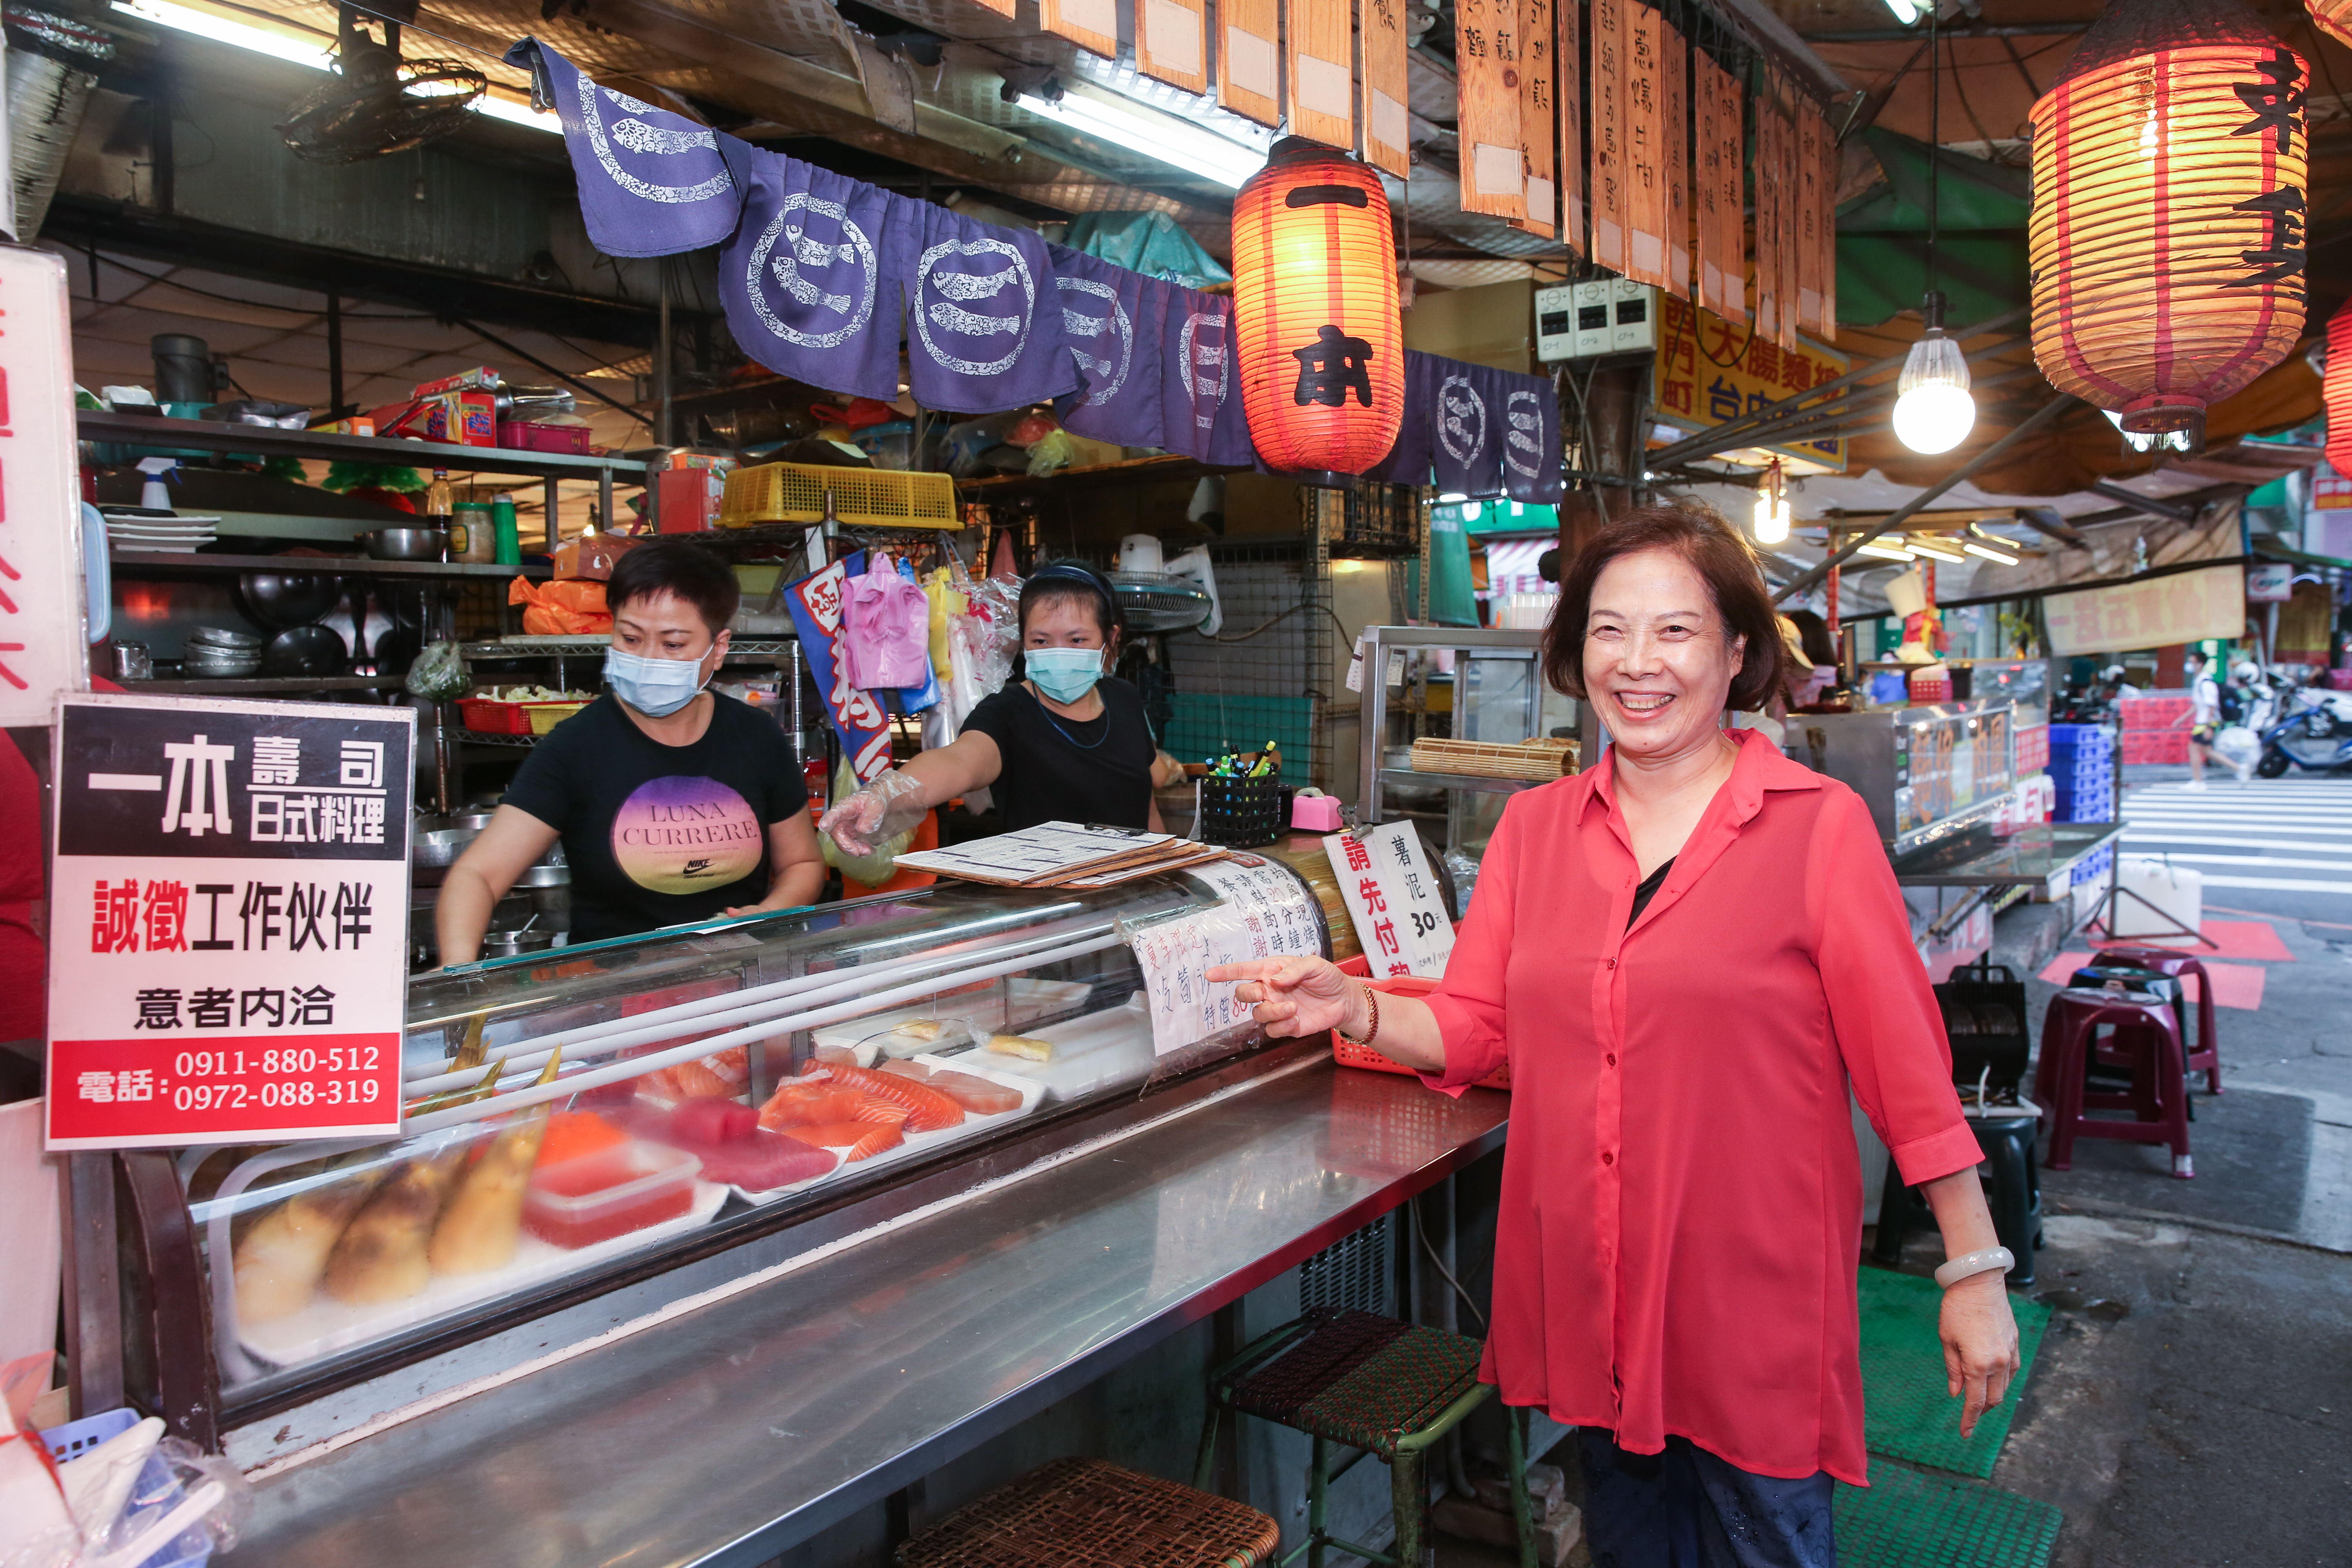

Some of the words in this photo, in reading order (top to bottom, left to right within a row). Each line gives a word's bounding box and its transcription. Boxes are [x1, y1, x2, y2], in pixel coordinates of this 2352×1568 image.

[1285, 184, 1373, 408] 一本
[88, 735, 234, 836] 一本
[252, 736, 384, 787] 壽司
[250, 793, 385, 844] 日式料理
[624, 821, 757, 845] CURRERE
[650, 803, 726, 822] LUNA
[687, 859, 710, 868] NIKE
[1391, 835, 1426, 903] 薯泥
[91, 879, 372, 953] 誠徵工作伙伴
[1145, 924, 1204, 972] 夏季限定
[1203, 996, 1255, 1031] 特價80
[175, 1046, 379, 1077] 0911-880-512
[174, 1079, 379, 1111] 0972-088-319
